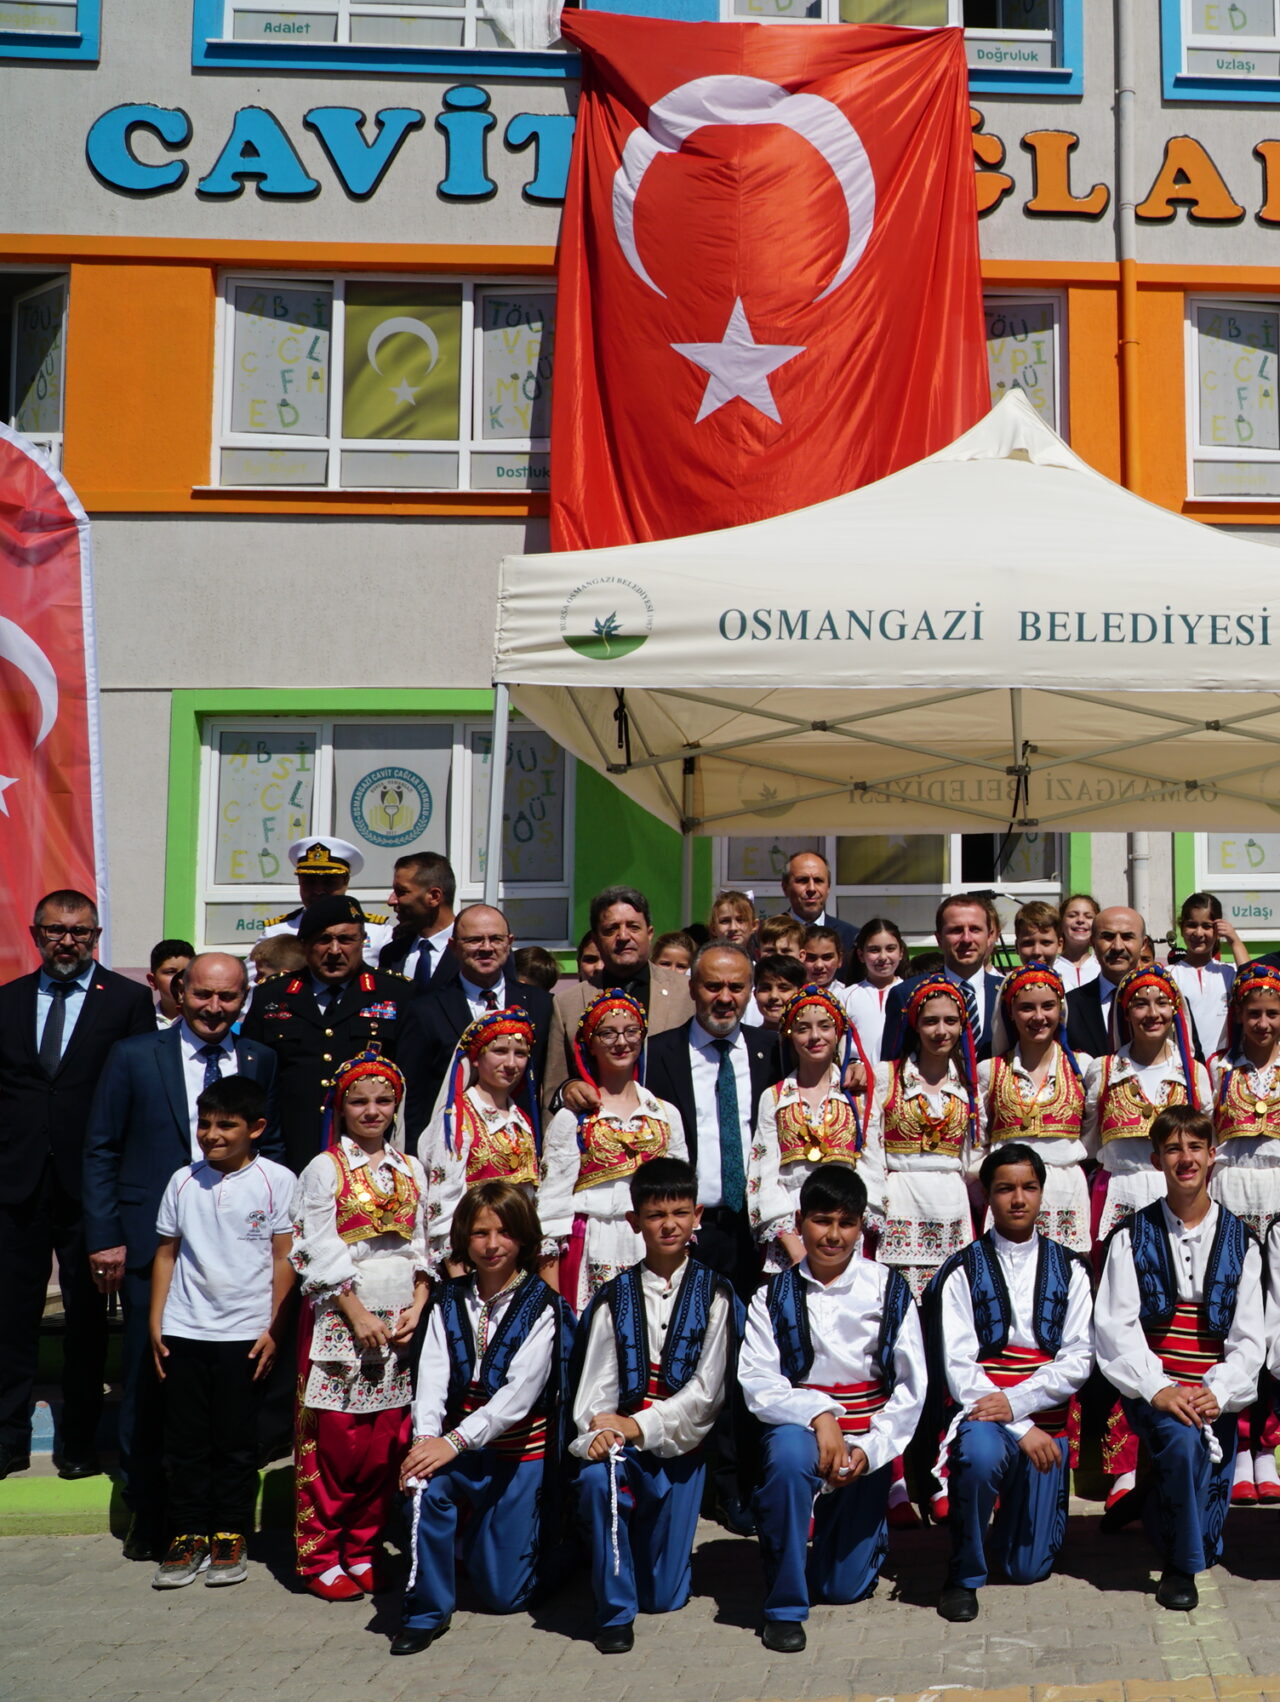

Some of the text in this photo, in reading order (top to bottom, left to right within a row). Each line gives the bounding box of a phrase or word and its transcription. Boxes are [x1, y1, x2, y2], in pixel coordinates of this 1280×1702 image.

[264, 22, 311, 34] Adalet
[977, 48, 1038, 63] Doğruluk
[1216, 59, 1255, 73] Uzlaşı
[87, 84, 576, 201] CAVİT
[719, 602, 1272, 646] OSMANGAZİ BELEDİYESİ
[1232, 905, 1272, 920] Uzlaşı
[236, 918, 265, 931] Ada
